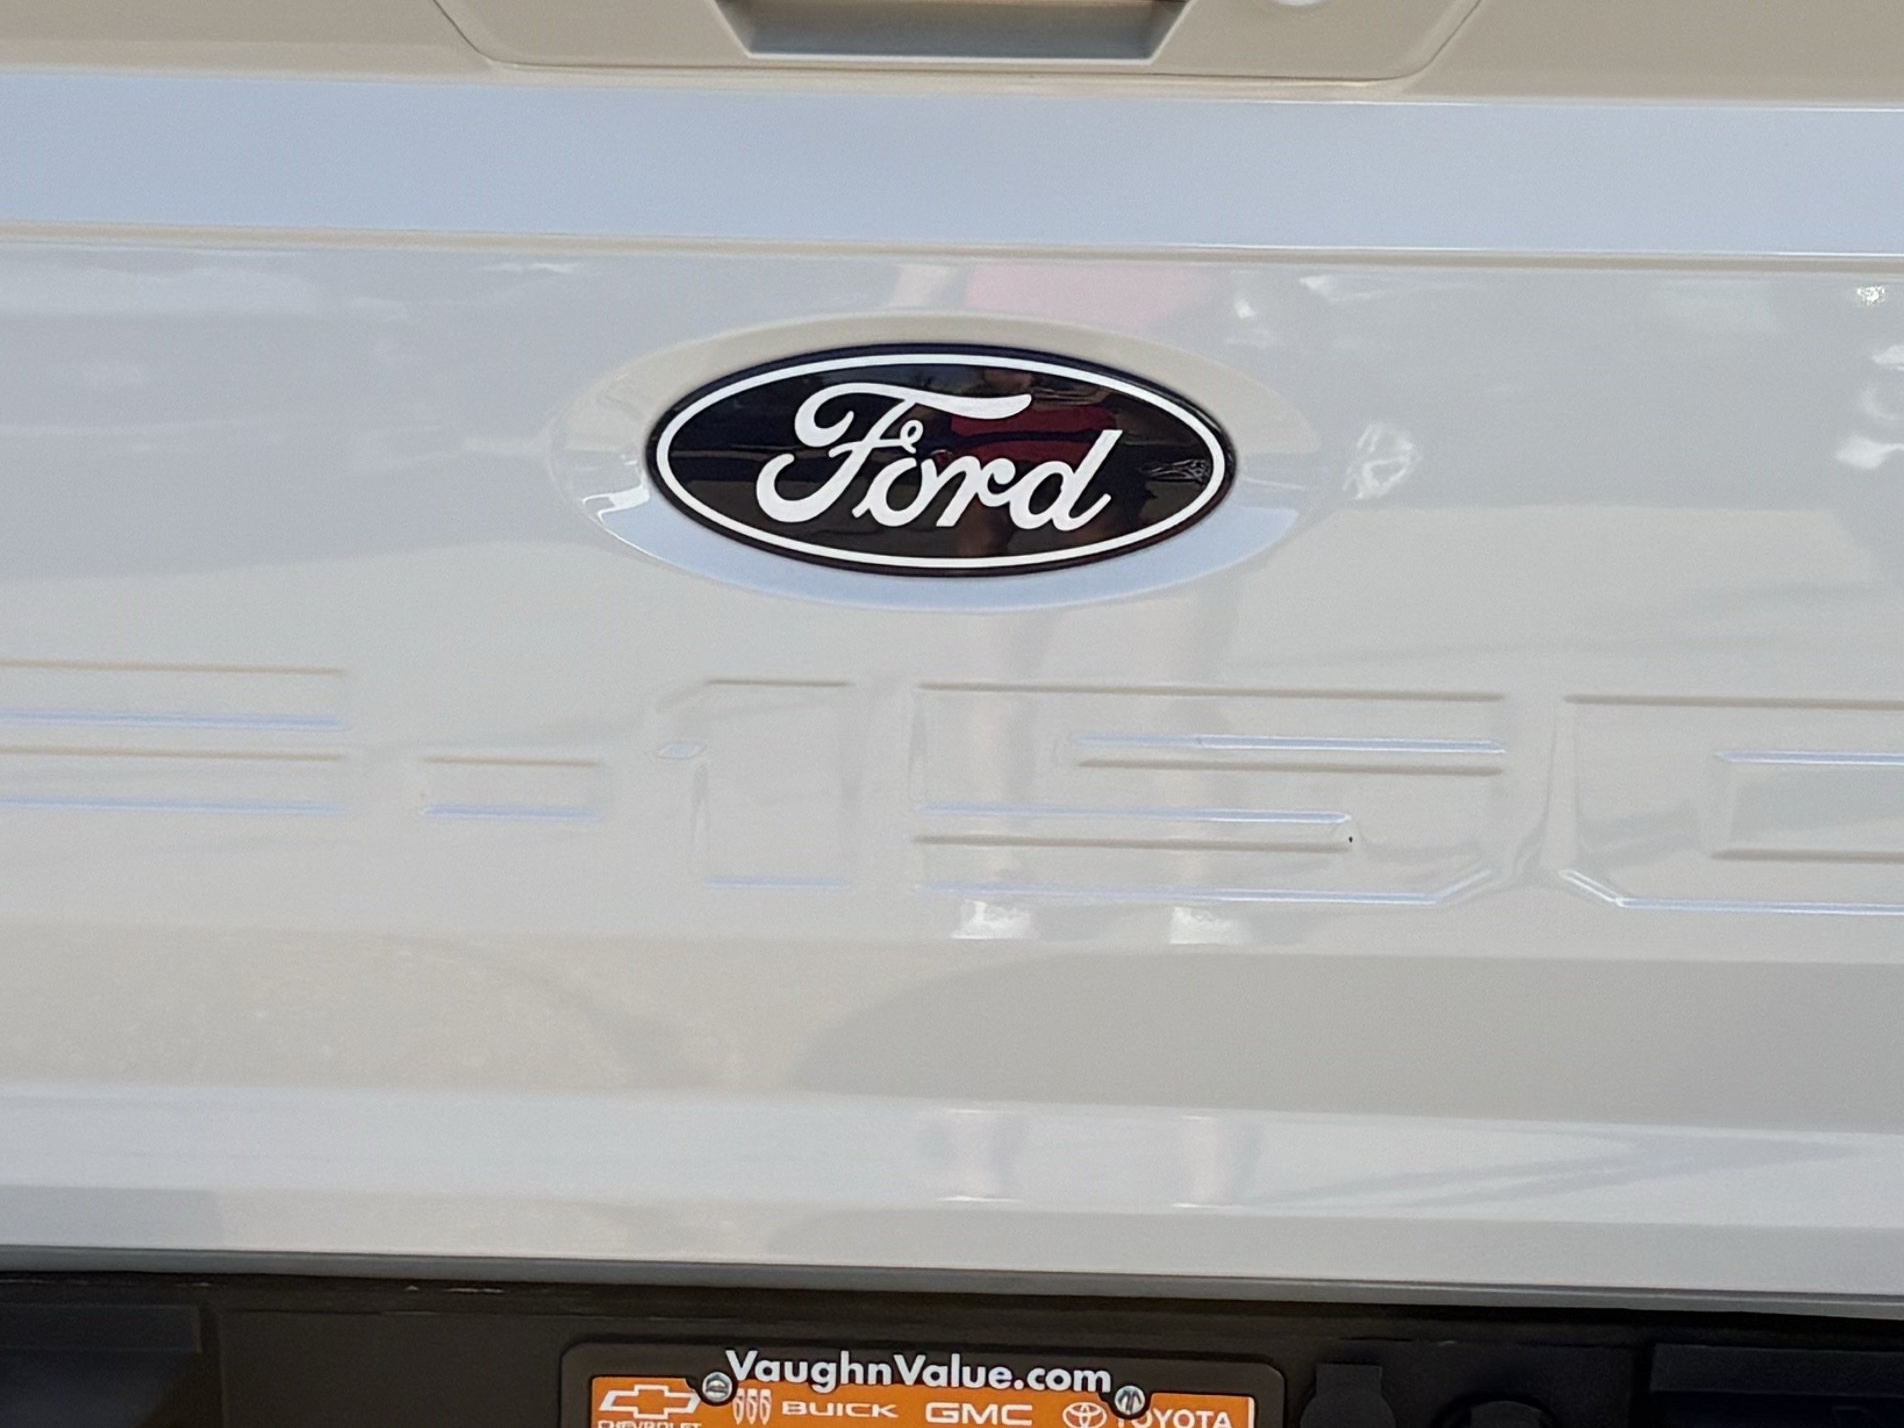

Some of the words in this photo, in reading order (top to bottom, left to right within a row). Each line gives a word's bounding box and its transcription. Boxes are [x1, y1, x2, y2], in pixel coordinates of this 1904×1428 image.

[756, 382, 1124, 532] Ford
[725, 1350, 1111, 1394] VaughnValue.com
[782, 1401, 899, 1419] BUICK
[925, 1401, 1033, 1426] GMC
